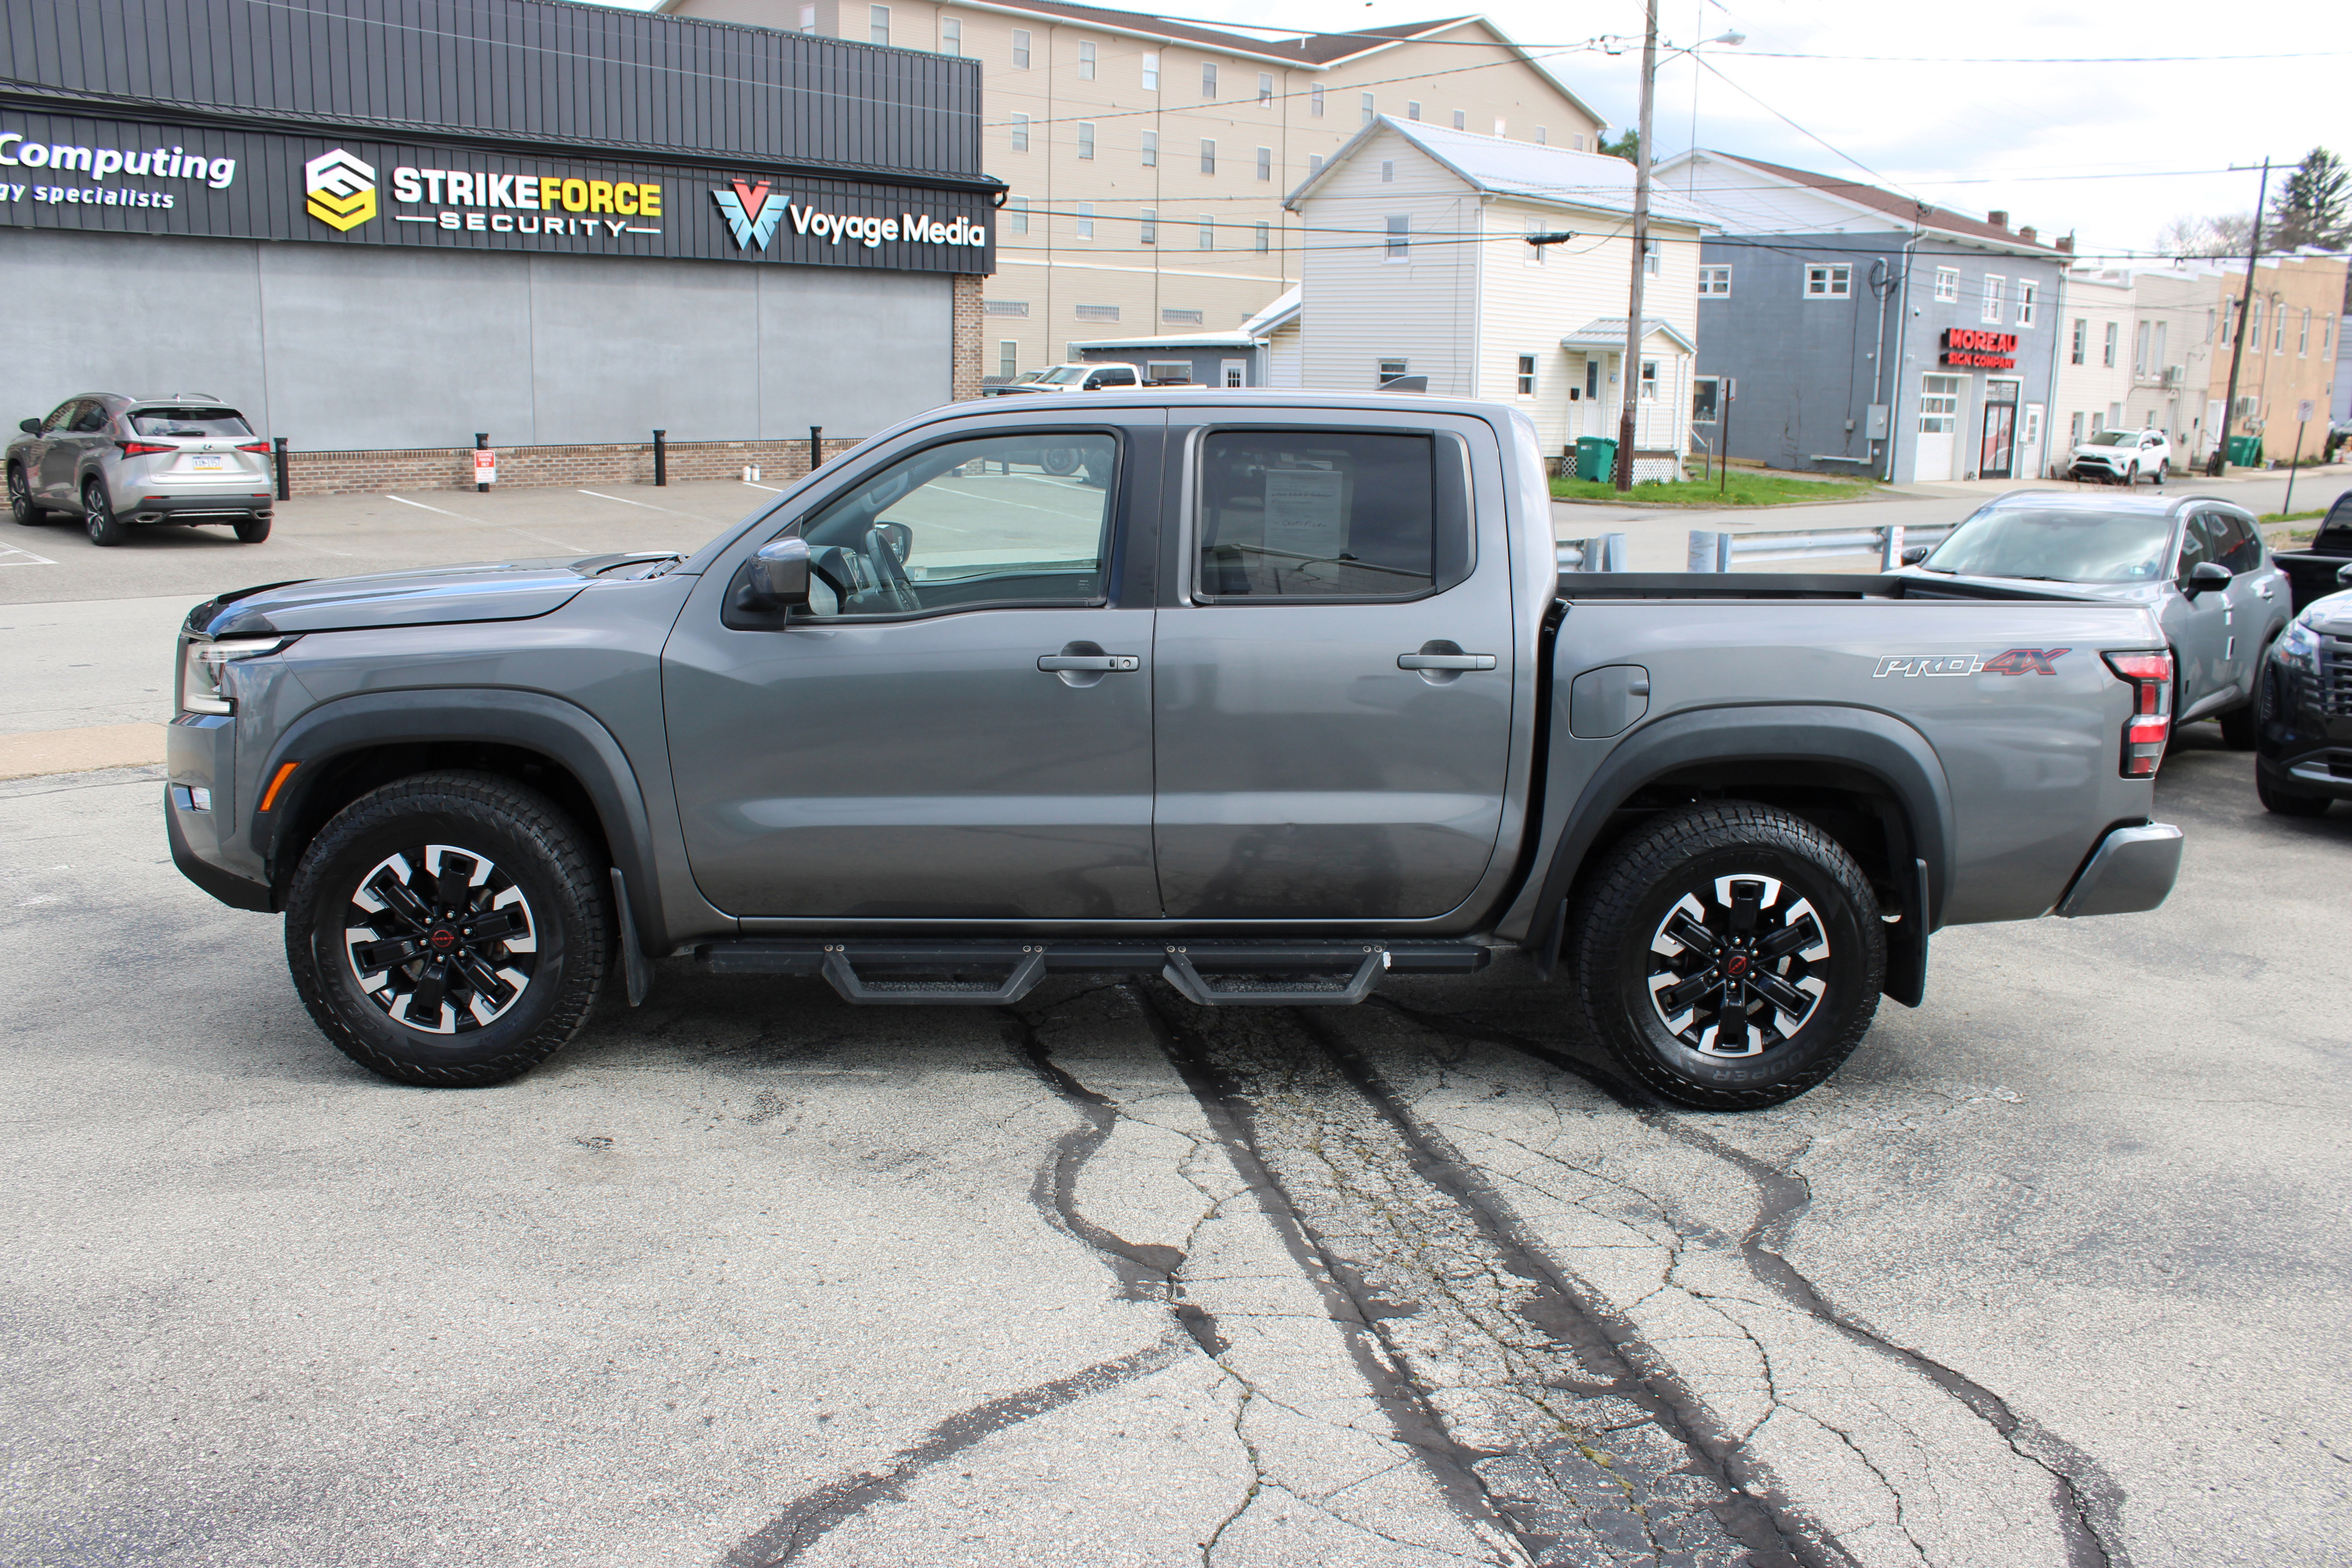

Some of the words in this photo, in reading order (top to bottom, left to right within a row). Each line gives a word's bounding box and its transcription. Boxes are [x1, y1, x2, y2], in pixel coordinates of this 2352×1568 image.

[0, 132, 236, 189] Computing
[33, 185, 174, 209] specialists
[393, 167, 662, 217] STRIKEFORCE
[439, 211, 627, 237] SECURITY
[790, 204, 898, 248] Voyage
[903, 213, 985, 247] Media
[1949, 327, 2019, 352] MOREAU
[1948, 352, 1973, 365] SIGN
[1974, 354, 2017, 369] COMPANY
[1872, 648, 2073, 678] PRO-4X
[1712, 1040, 1819, 1082] COOPER
